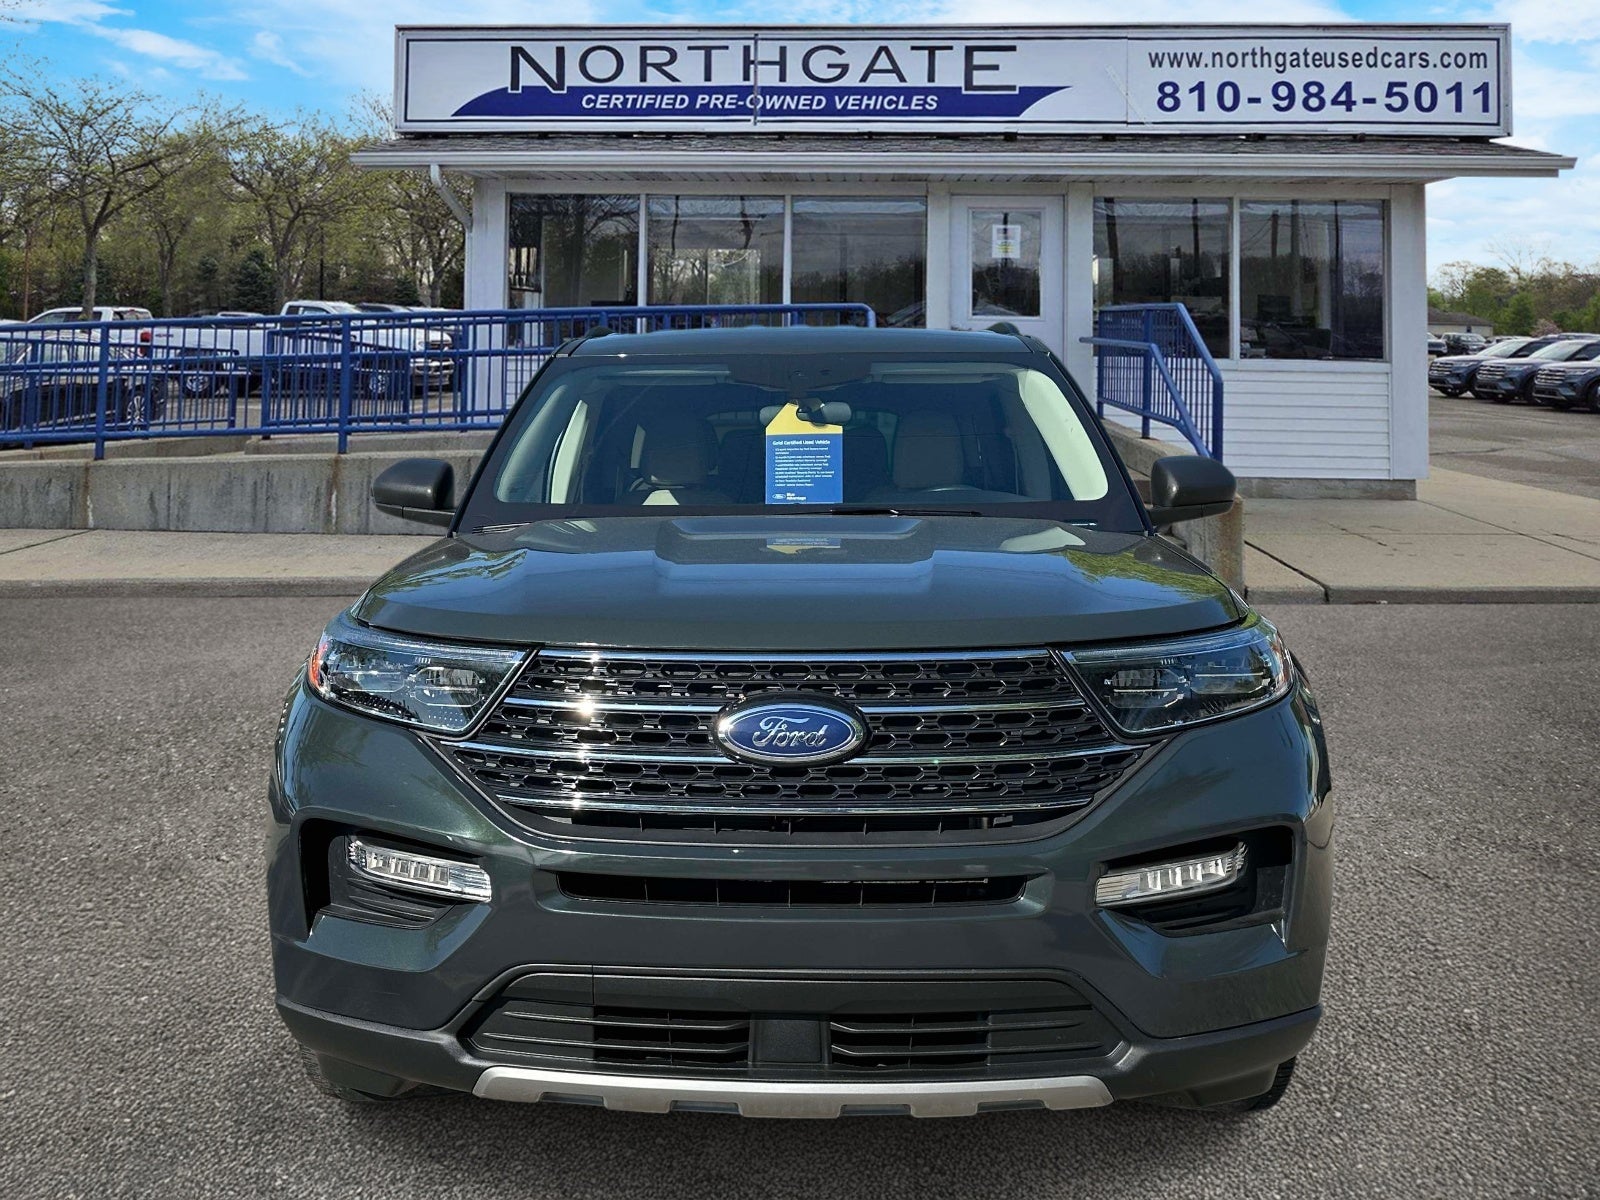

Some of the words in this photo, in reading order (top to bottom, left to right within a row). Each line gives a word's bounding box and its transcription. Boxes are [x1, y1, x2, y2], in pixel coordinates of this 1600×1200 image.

[510, 45, 1018, 94] NORTHGATE
[1149, 46, 1489, 74] www.northgateusedcars.com
[581, 94, 687, 110] CERTIFIED
[696, 94, 827, 111] PRE-OWNED
[834, 95, 939, 111] VEHICLES
[1157, 81, 1491, 113] 810-984-5011
[752, 716, 829, 747] Ford
